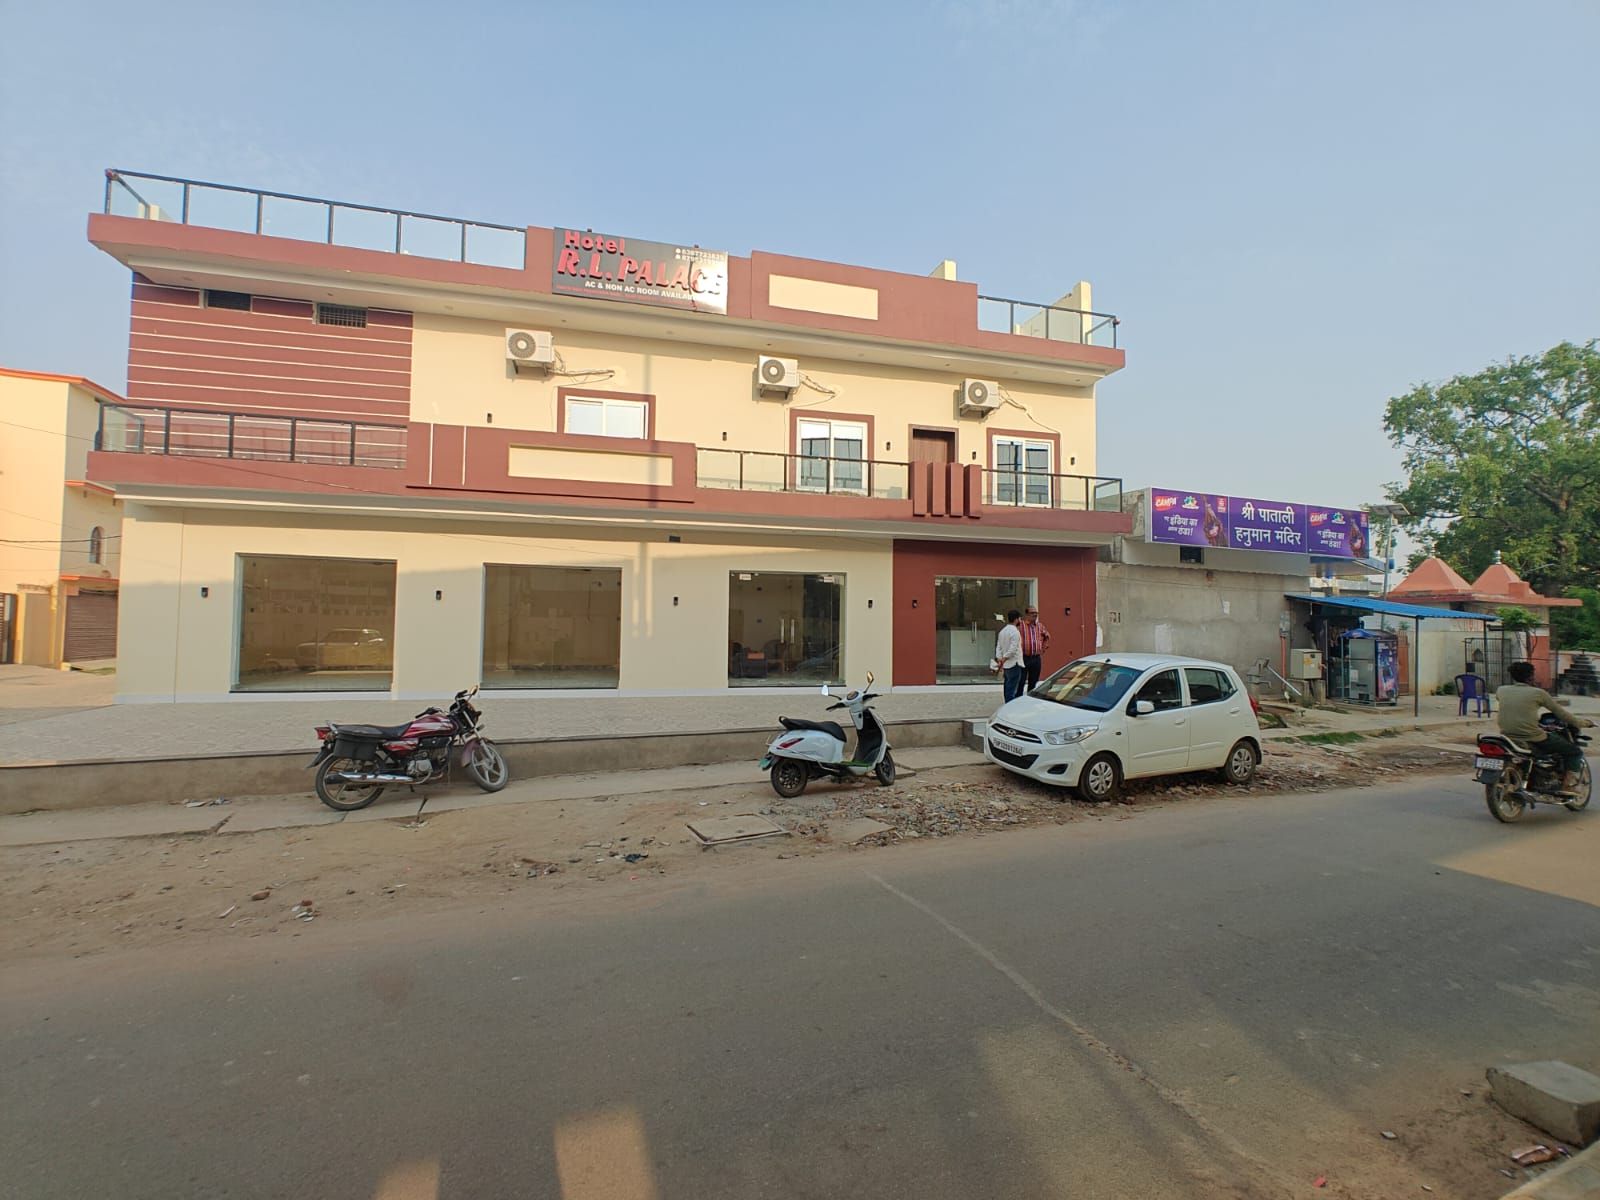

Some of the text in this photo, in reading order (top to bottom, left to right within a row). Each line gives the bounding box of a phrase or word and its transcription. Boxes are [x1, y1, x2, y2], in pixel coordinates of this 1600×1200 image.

[564, 230, 625, 256] Hotel
[585, 281, 596, 289] AC
[606, 283, 623, 291] NON
[624, 285, 635, 293] AC
[637, 287, 660, 296] ROOM
[661, 289, 697, 301] AVAILAB
[1241, 502, 1255, 521] श्री
[1258, 506, 1295, 524] पाताली
[1234, 526, 1301, 547] हनुमान मंदिर
